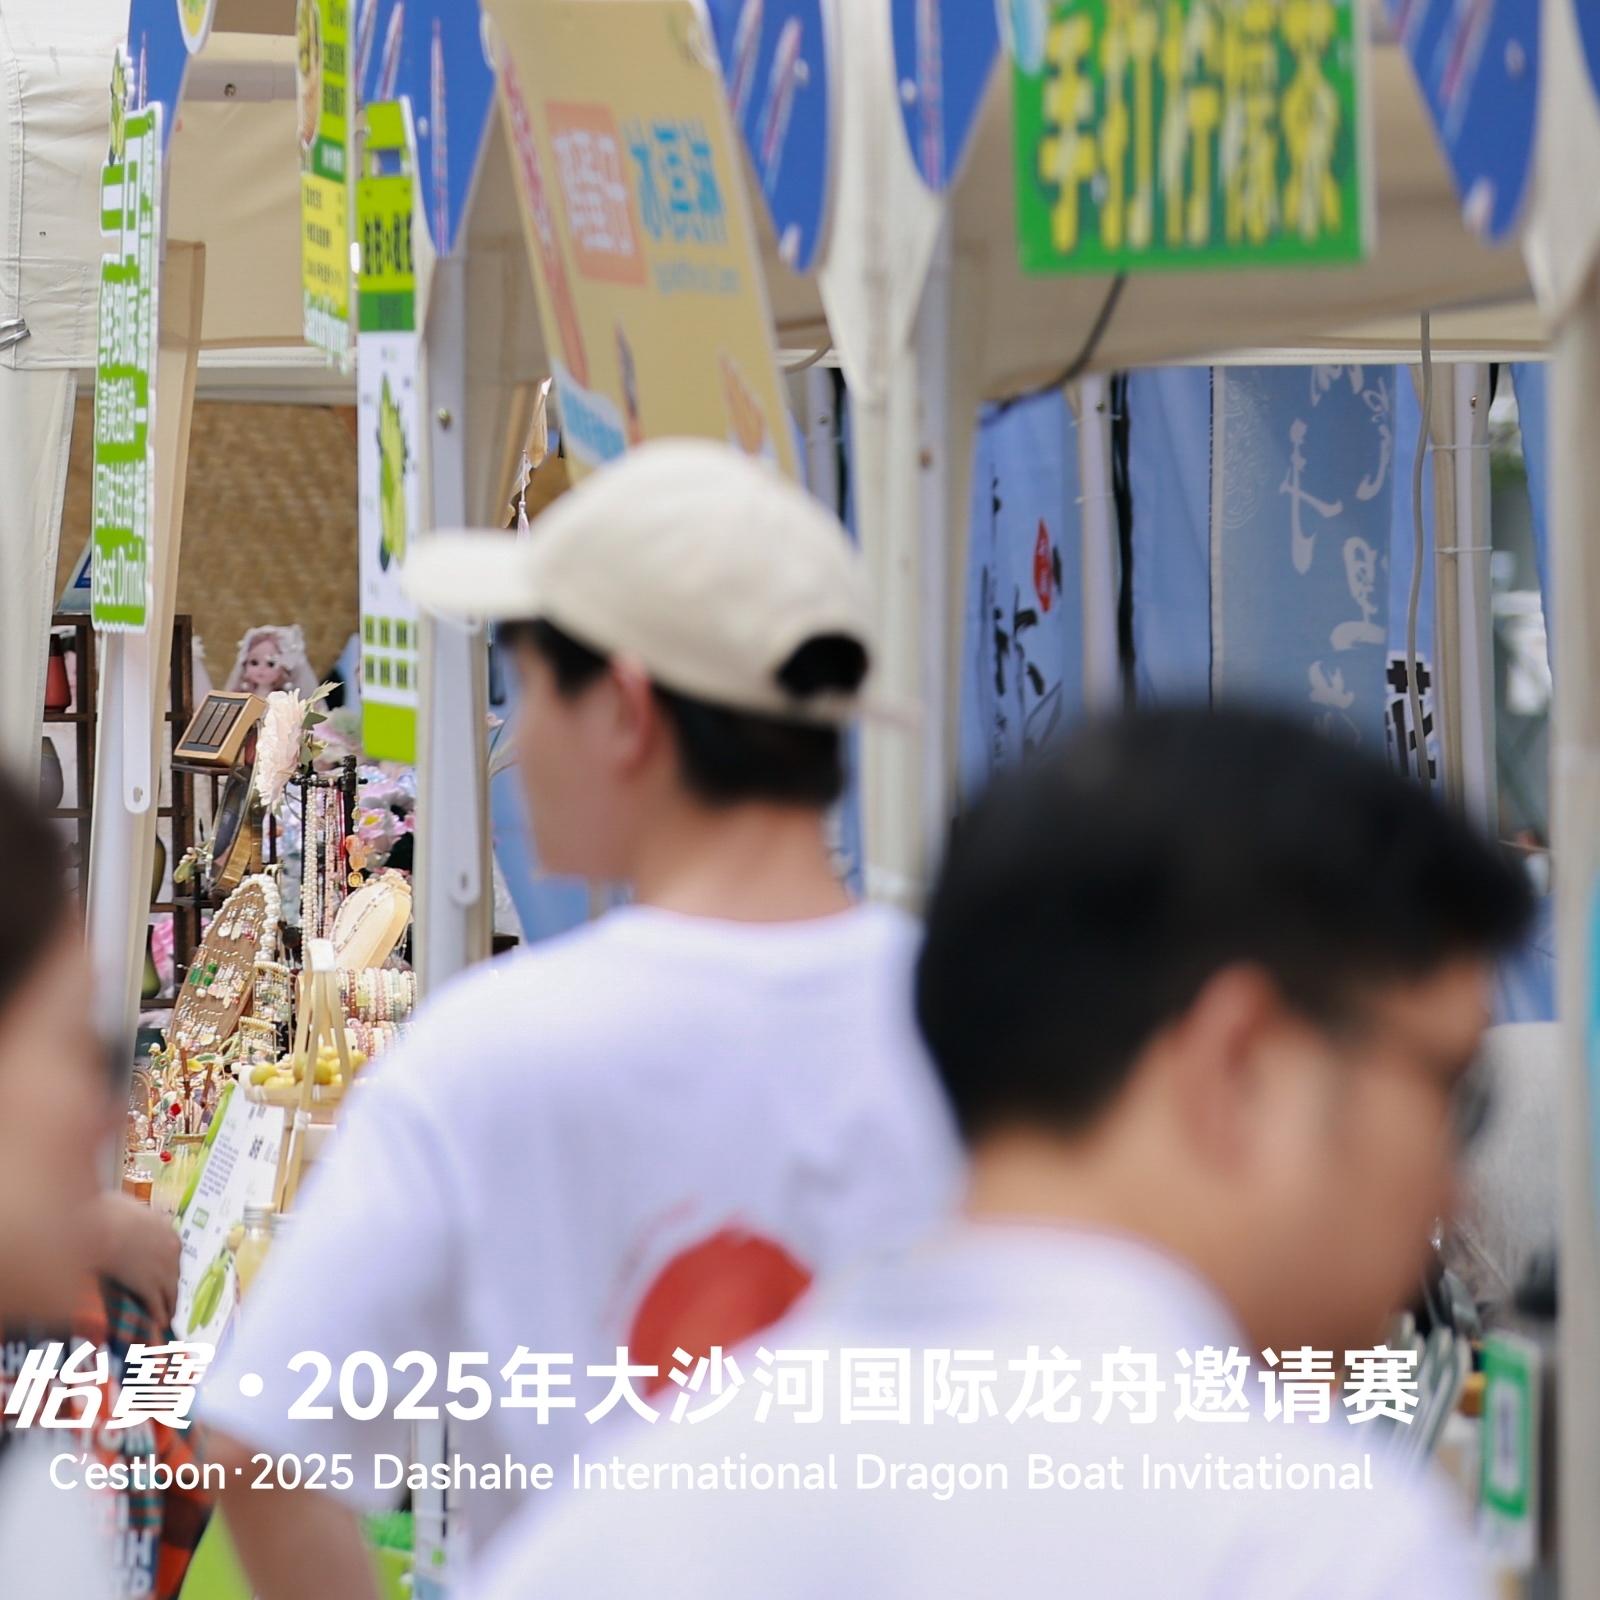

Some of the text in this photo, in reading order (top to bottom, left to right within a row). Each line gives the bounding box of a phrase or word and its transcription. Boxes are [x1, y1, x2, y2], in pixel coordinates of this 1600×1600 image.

[99, 280, 138, 367] 鲜到底
[95, 463, 133, 528] 回味甘甜
[94, 543, 145, 606] Best Drink
